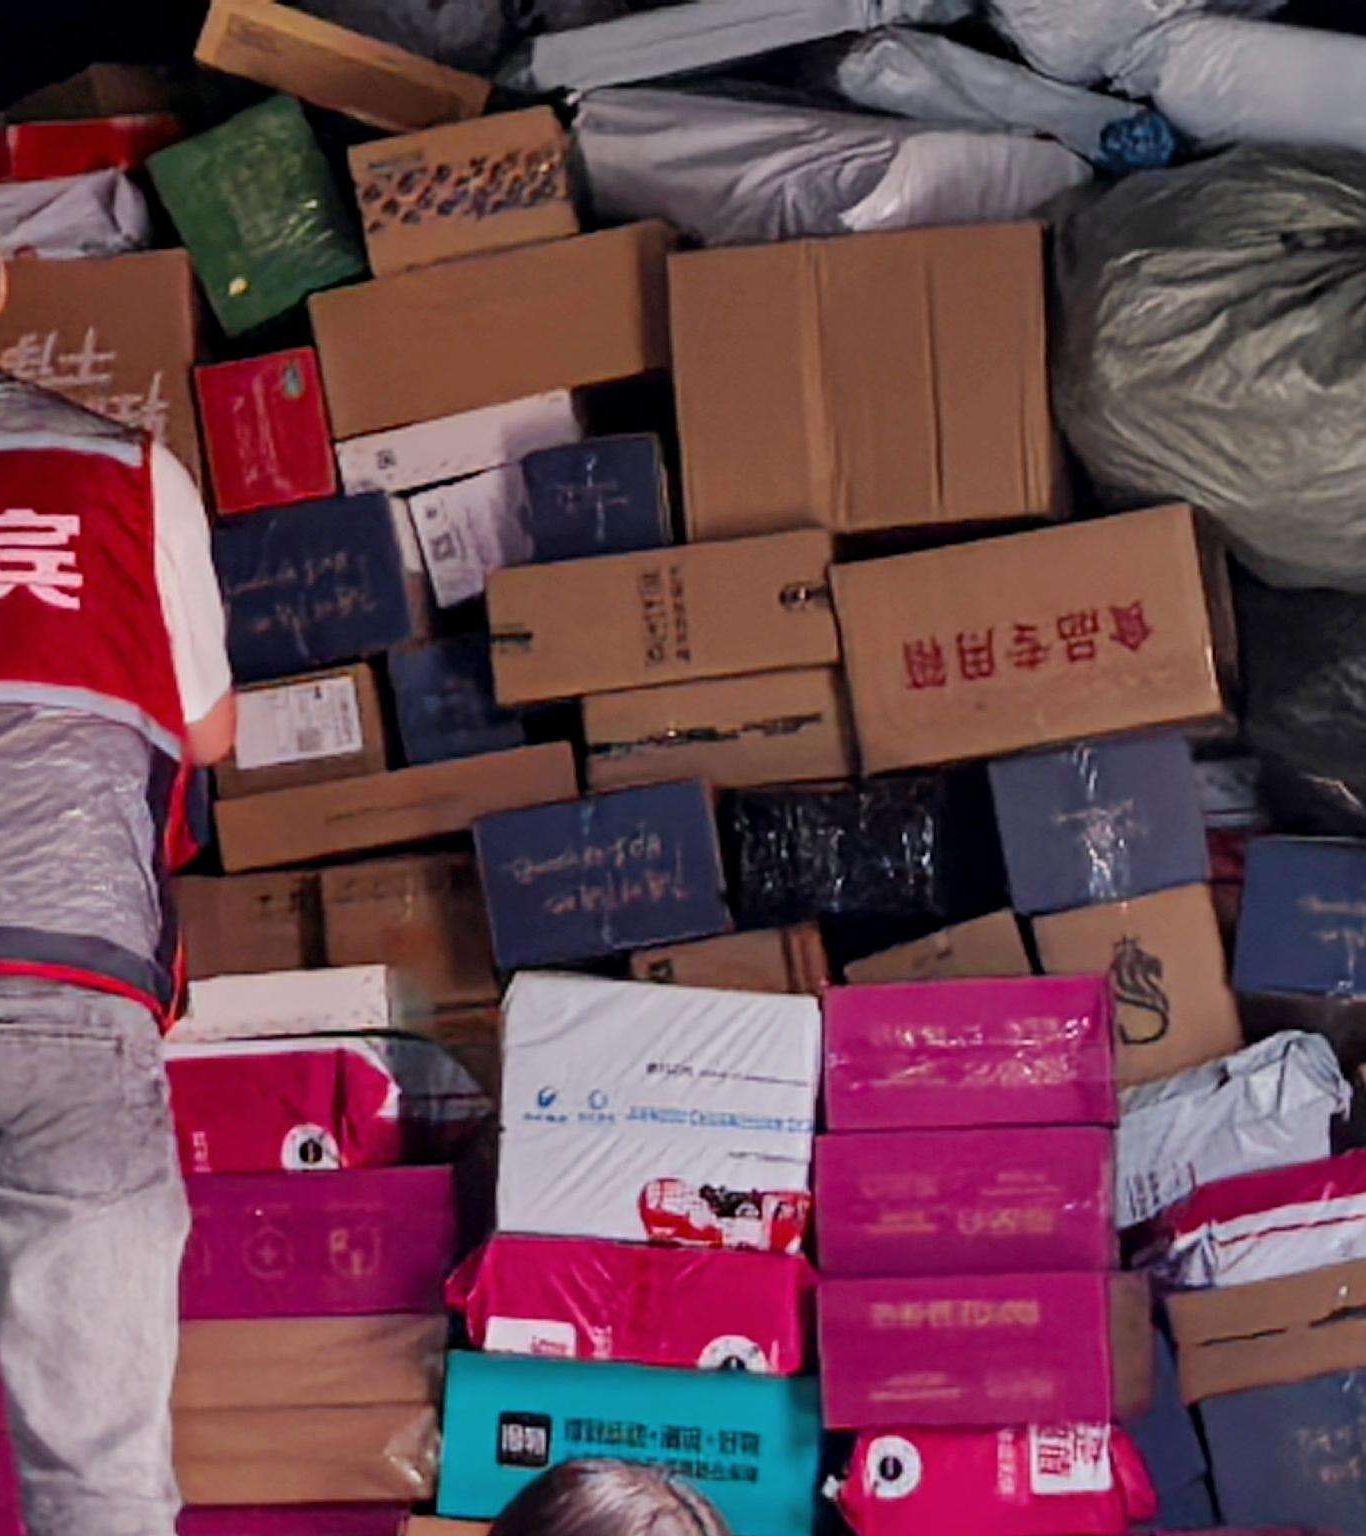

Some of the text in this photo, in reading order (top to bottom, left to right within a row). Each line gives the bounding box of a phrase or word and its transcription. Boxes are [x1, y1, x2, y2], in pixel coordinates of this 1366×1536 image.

[901, 600, 1155, 692] 食品专用箱
